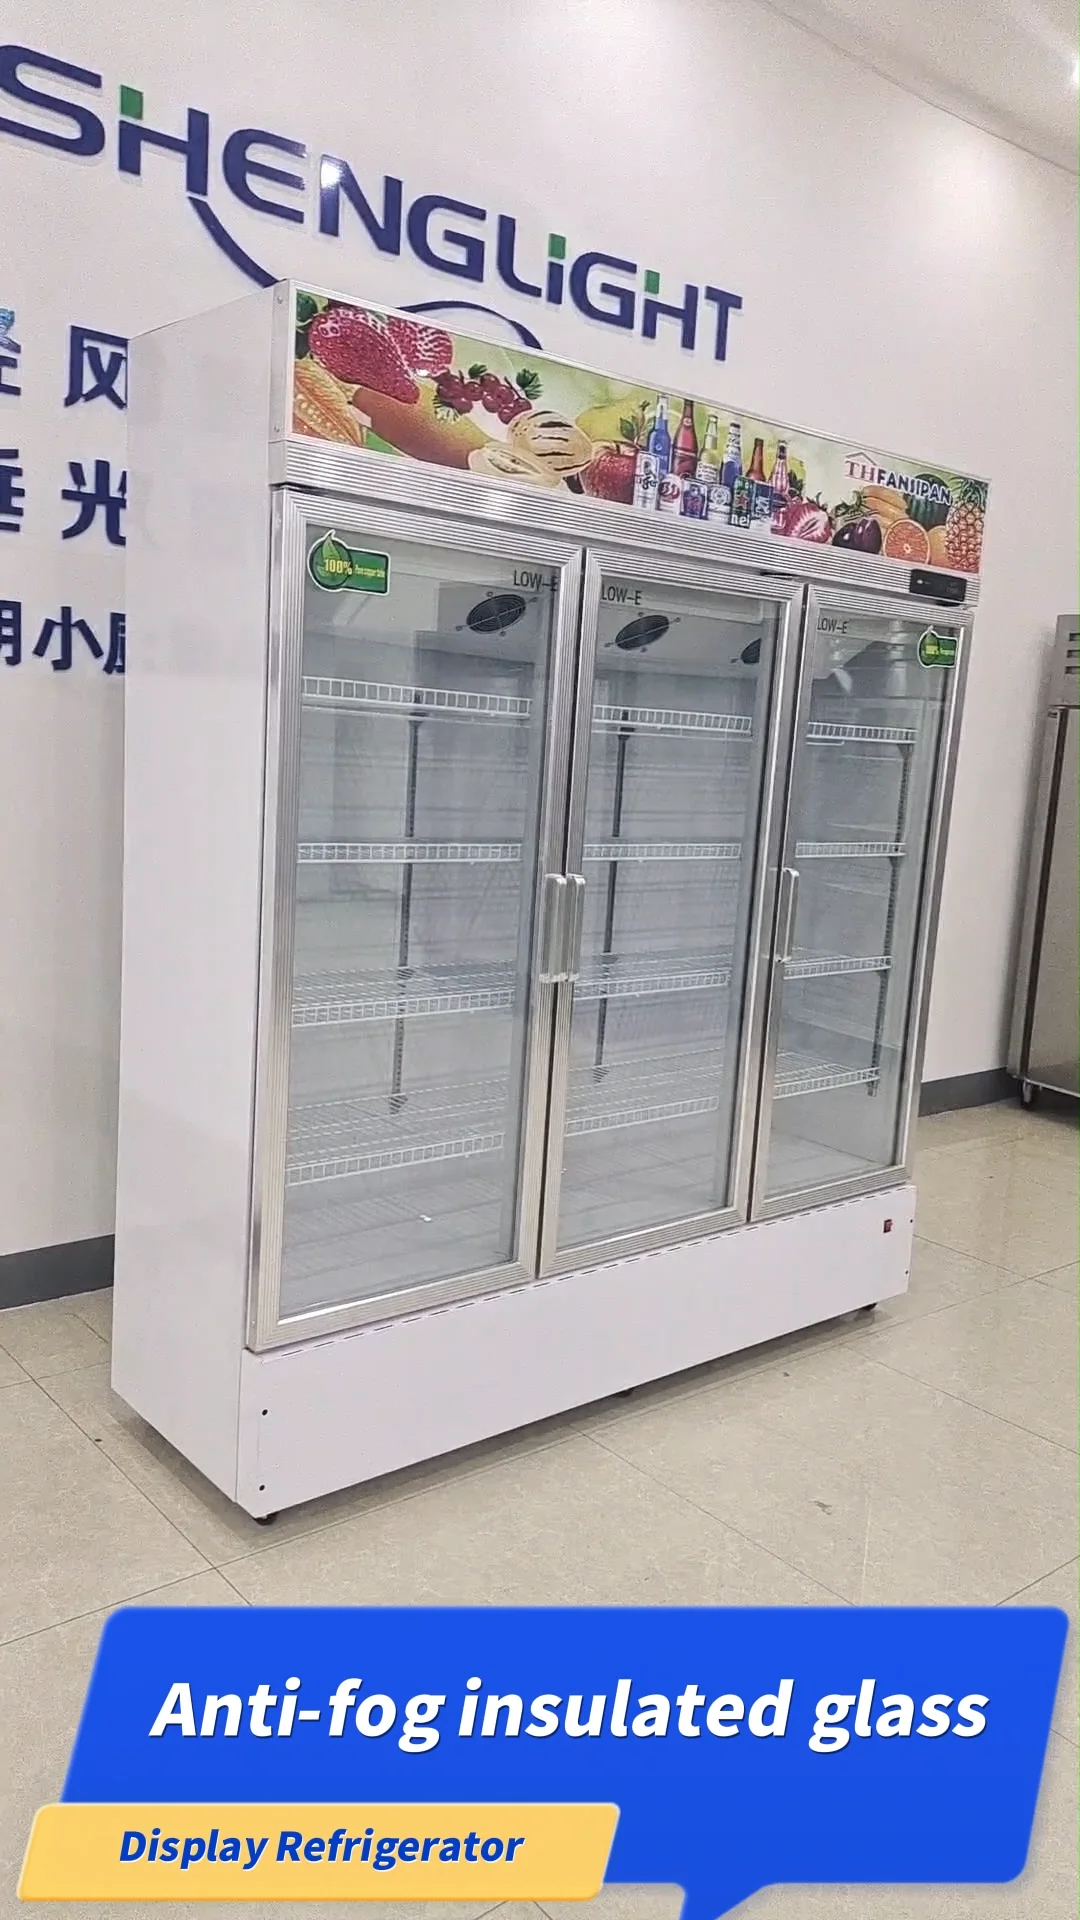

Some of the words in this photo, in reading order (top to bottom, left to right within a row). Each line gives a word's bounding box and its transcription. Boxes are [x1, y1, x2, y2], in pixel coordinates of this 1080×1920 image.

[325, 559, 353, 576] 100%
[513, 569, 558, 592] LOW-E
[602, 584, 642, 605] LOW-E
[817, 616, 849, 634] LOW-E
